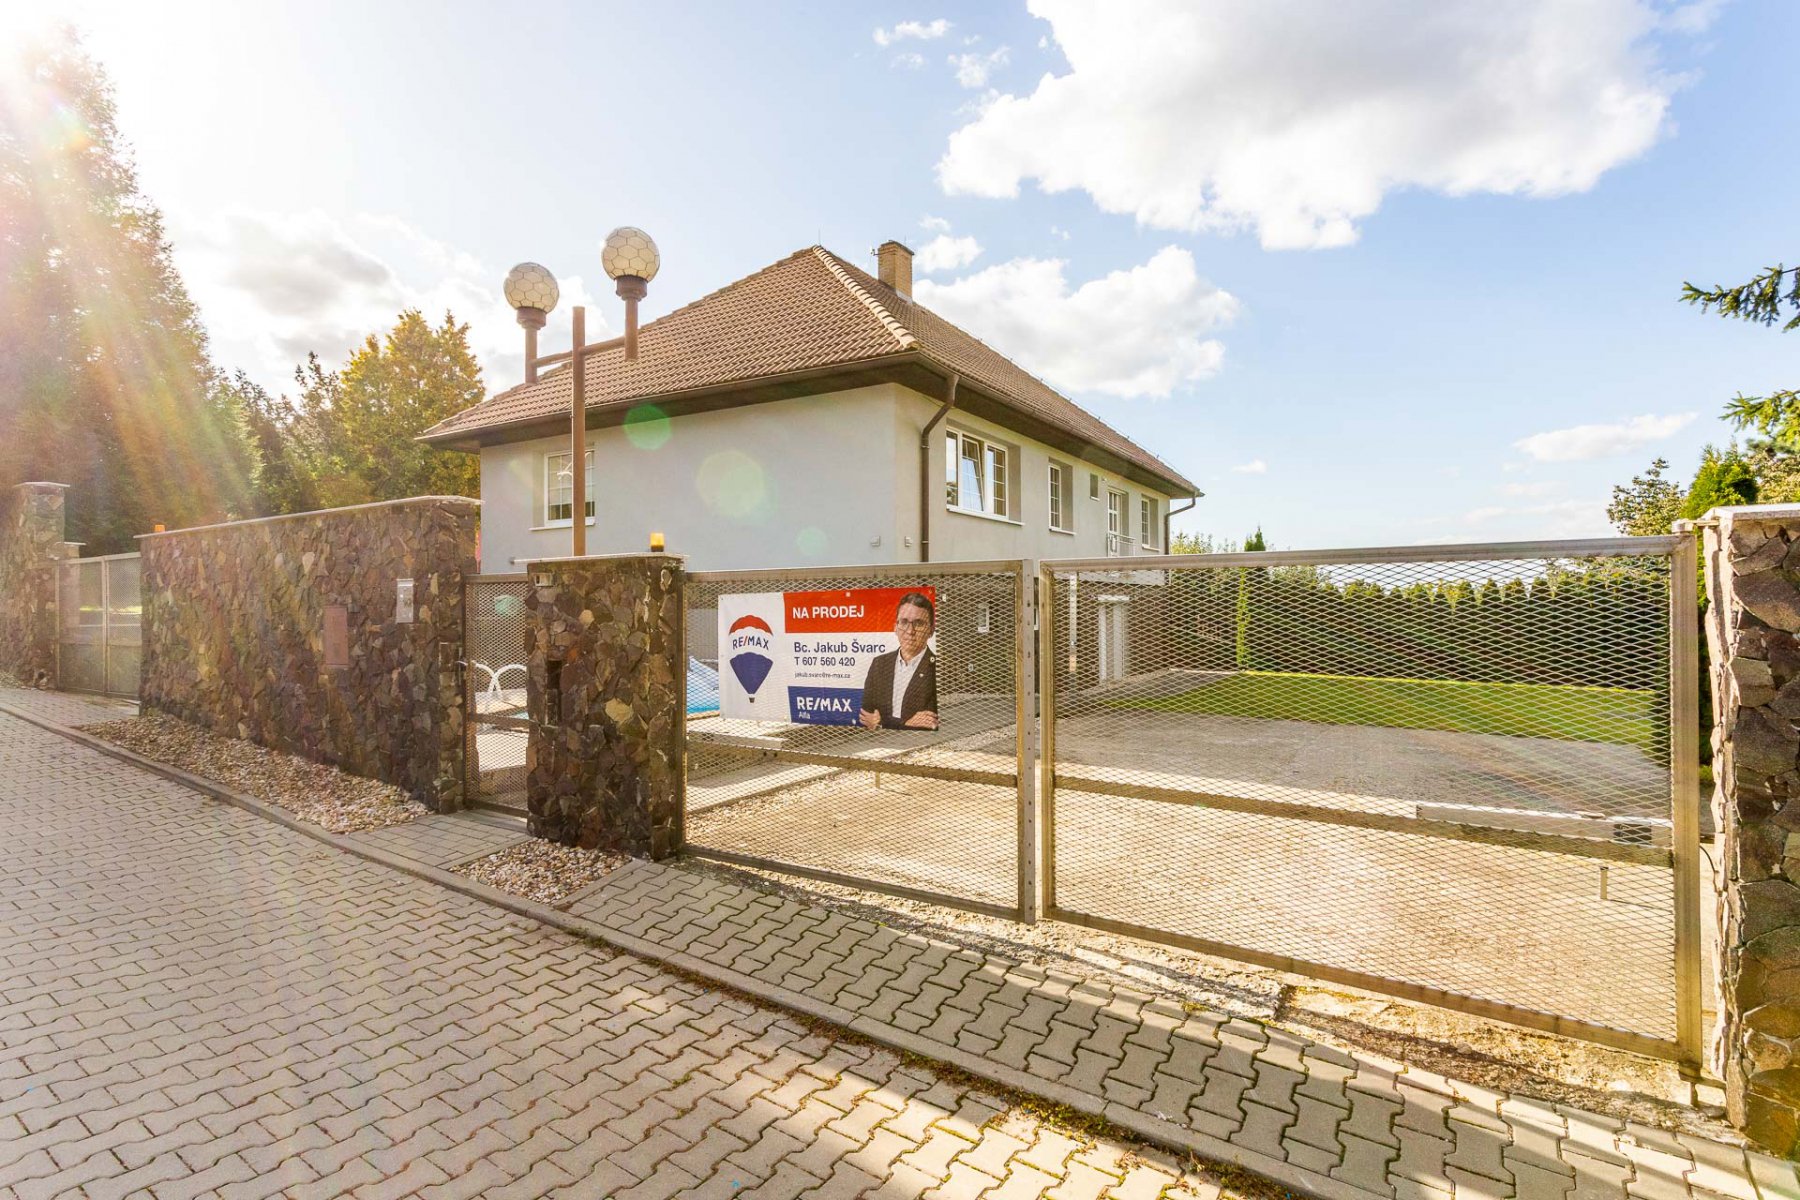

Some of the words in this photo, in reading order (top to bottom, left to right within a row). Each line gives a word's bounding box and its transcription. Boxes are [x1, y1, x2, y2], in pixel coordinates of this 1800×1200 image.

[792, 606, 810, 619] NA
[812, 605, 865, 619] PRODEJ
[732, 635, 769, 650] RE/MAX
[794, 641, 811, 653] Bc.
[813, 641, 848, 653] Jakub
[851, 638, 886, 654] Švarc
[794, 656, 800, 666] T
[802, 656, 817, 666] 607
[820, 657, 836, 666] 560
[838, 657, 856, 667] 420
[796, 696, 853, 712] RE/MAX
